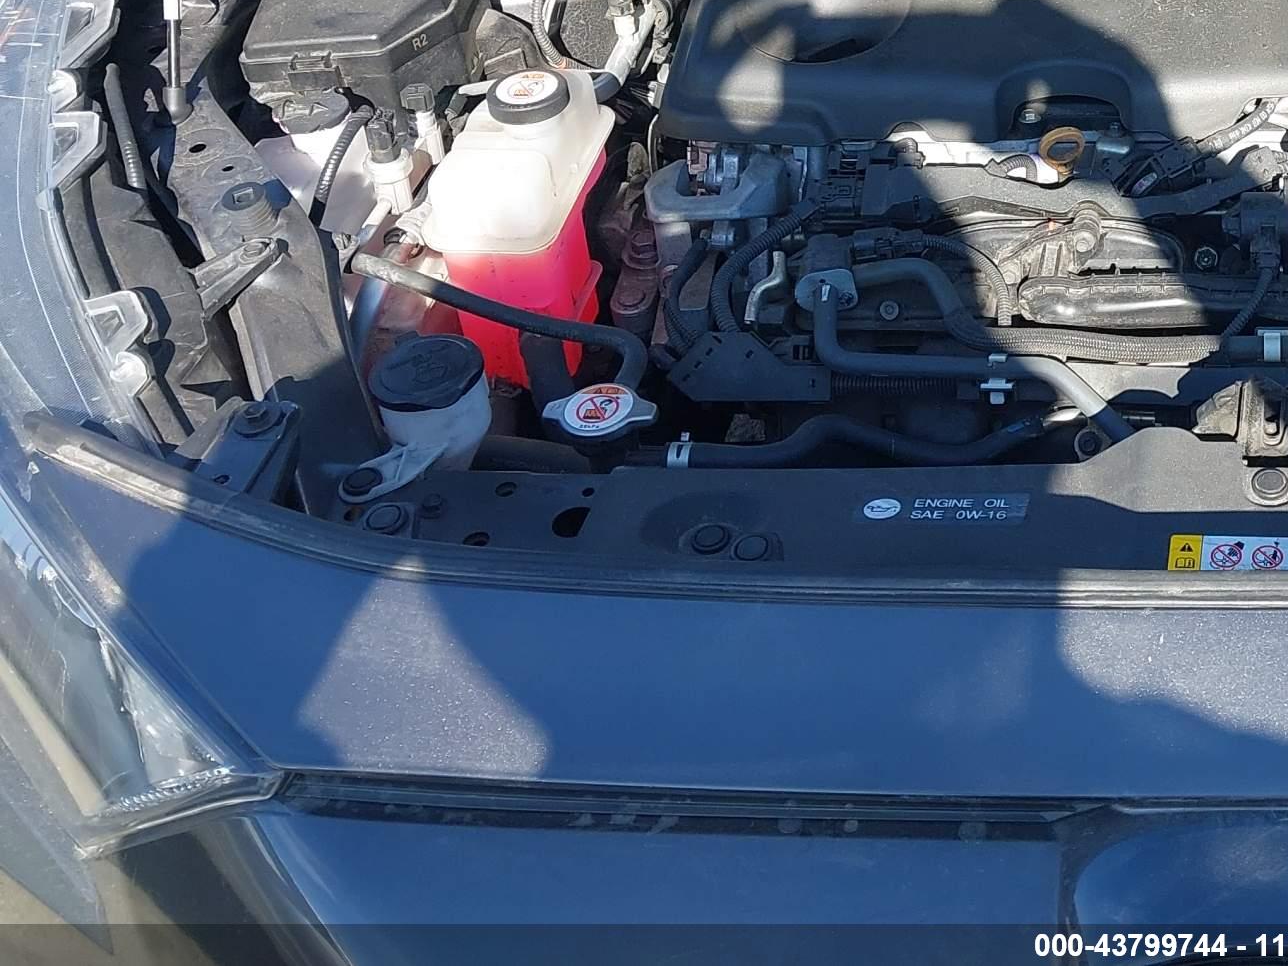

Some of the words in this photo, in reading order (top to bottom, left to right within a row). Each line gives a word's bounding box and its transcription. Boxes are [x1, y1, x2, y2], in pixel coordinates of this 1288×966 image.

[411, 33, 429, 51] R2
[914, 498, 975, 508] ENGINE
[984, 498, 1009, 508] OIL
[910, 510, 945, 520] SAE
[956, 510, 1008, 520] 0W-16
